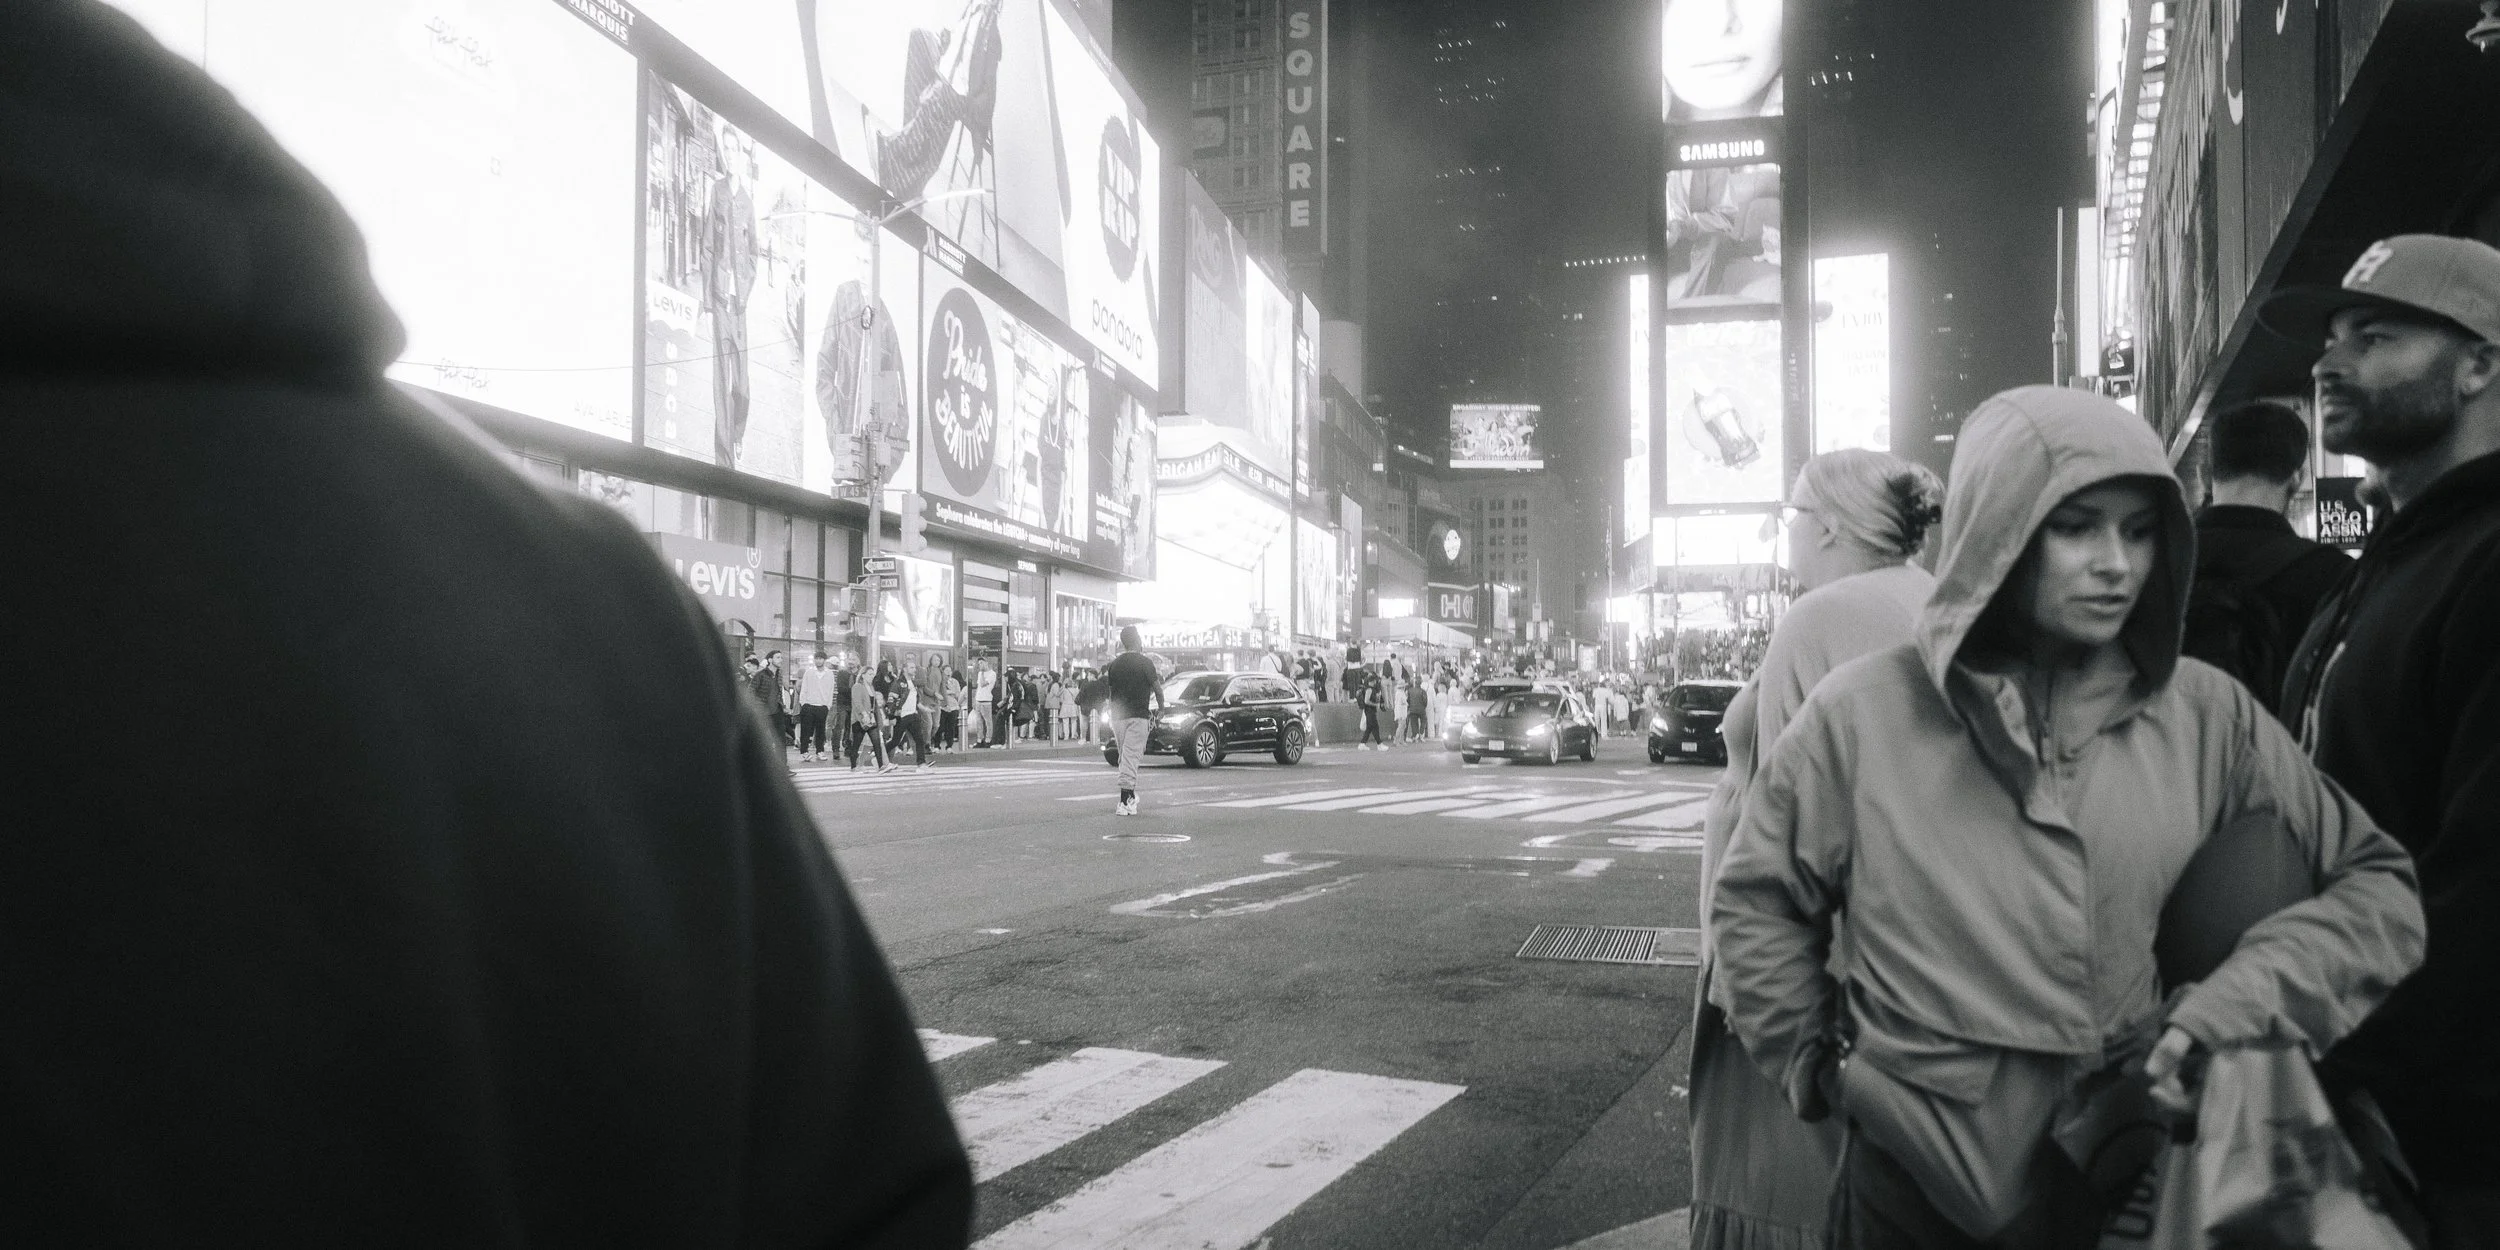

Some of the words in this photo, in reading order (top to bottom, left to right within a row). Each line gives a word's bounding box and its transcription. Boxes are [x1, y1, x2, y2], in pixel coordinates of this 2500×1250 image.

[1286, 11, 1314, 228] SQUARE
[1680, 139, 1765, 162] SAMSUNG
[1092, 296, 1143, 361] pandora
[942, 310, 988, 391] Pride
[961, 385, 971, 419] is
[935, 389, 993, 471] BEAUTIFUL
[936, 502, 963, 524] Sephora
[964, 510, 993, 533] celebrates
[2320, 511, 2362, 525] POLO
[881, 560, 895, 570] WAY
[881, 578, 898, 588] WAY
[1014, 629, 1048, 648] SEPHORA
